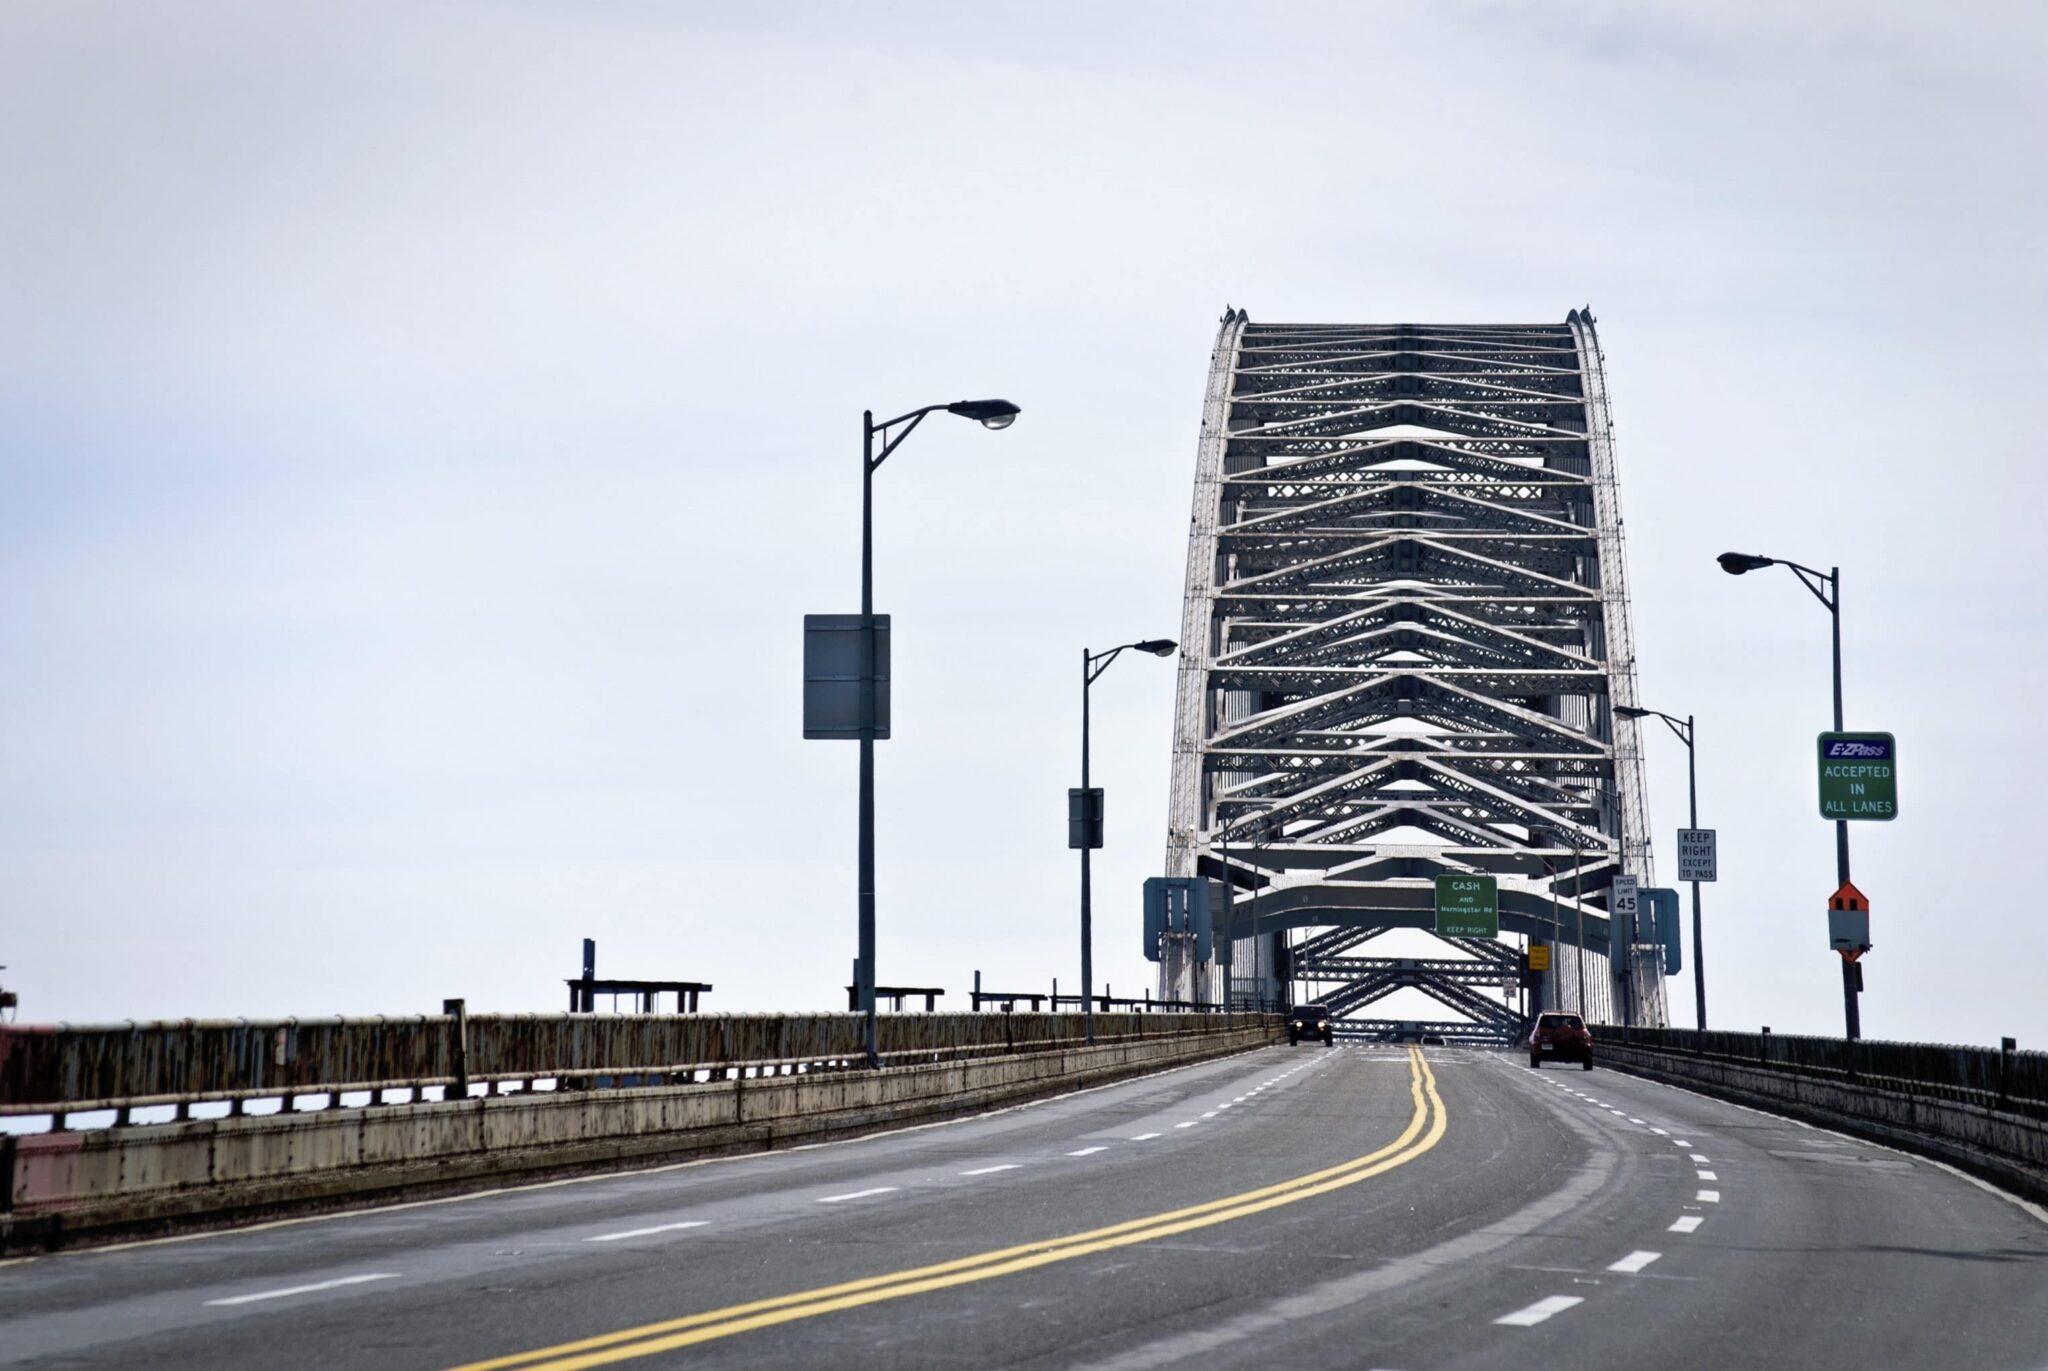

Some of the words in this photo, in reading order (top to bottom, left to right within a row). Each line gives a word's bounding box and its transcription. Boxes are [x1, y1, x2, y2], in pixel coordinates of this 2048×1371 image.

[1824, 766, 1890, 777] ACCEPTED
[1850, 783, 1865, 795] IN
[1825, 800, 1847, 812] ALL
[1853, 800, 1892, 813] LANES
[1683, 832, 1710, 843] KEEP
[1682, 846, 1711, 856] RIGHT
[1683, 859, 1711, 867] EXCEPT
[1682, 870, 1691, 878] TO
[1695, 870, 1713, 878] PASS
[1451, 881, 1481, 891] CASH
[1617, 887, 1633, 895] LIMIT
[1616, 898, 1636, 910] 45
[1446, 926, 1464, 934] KEEP
[1467, 926, 1487, 935] RIGHT
